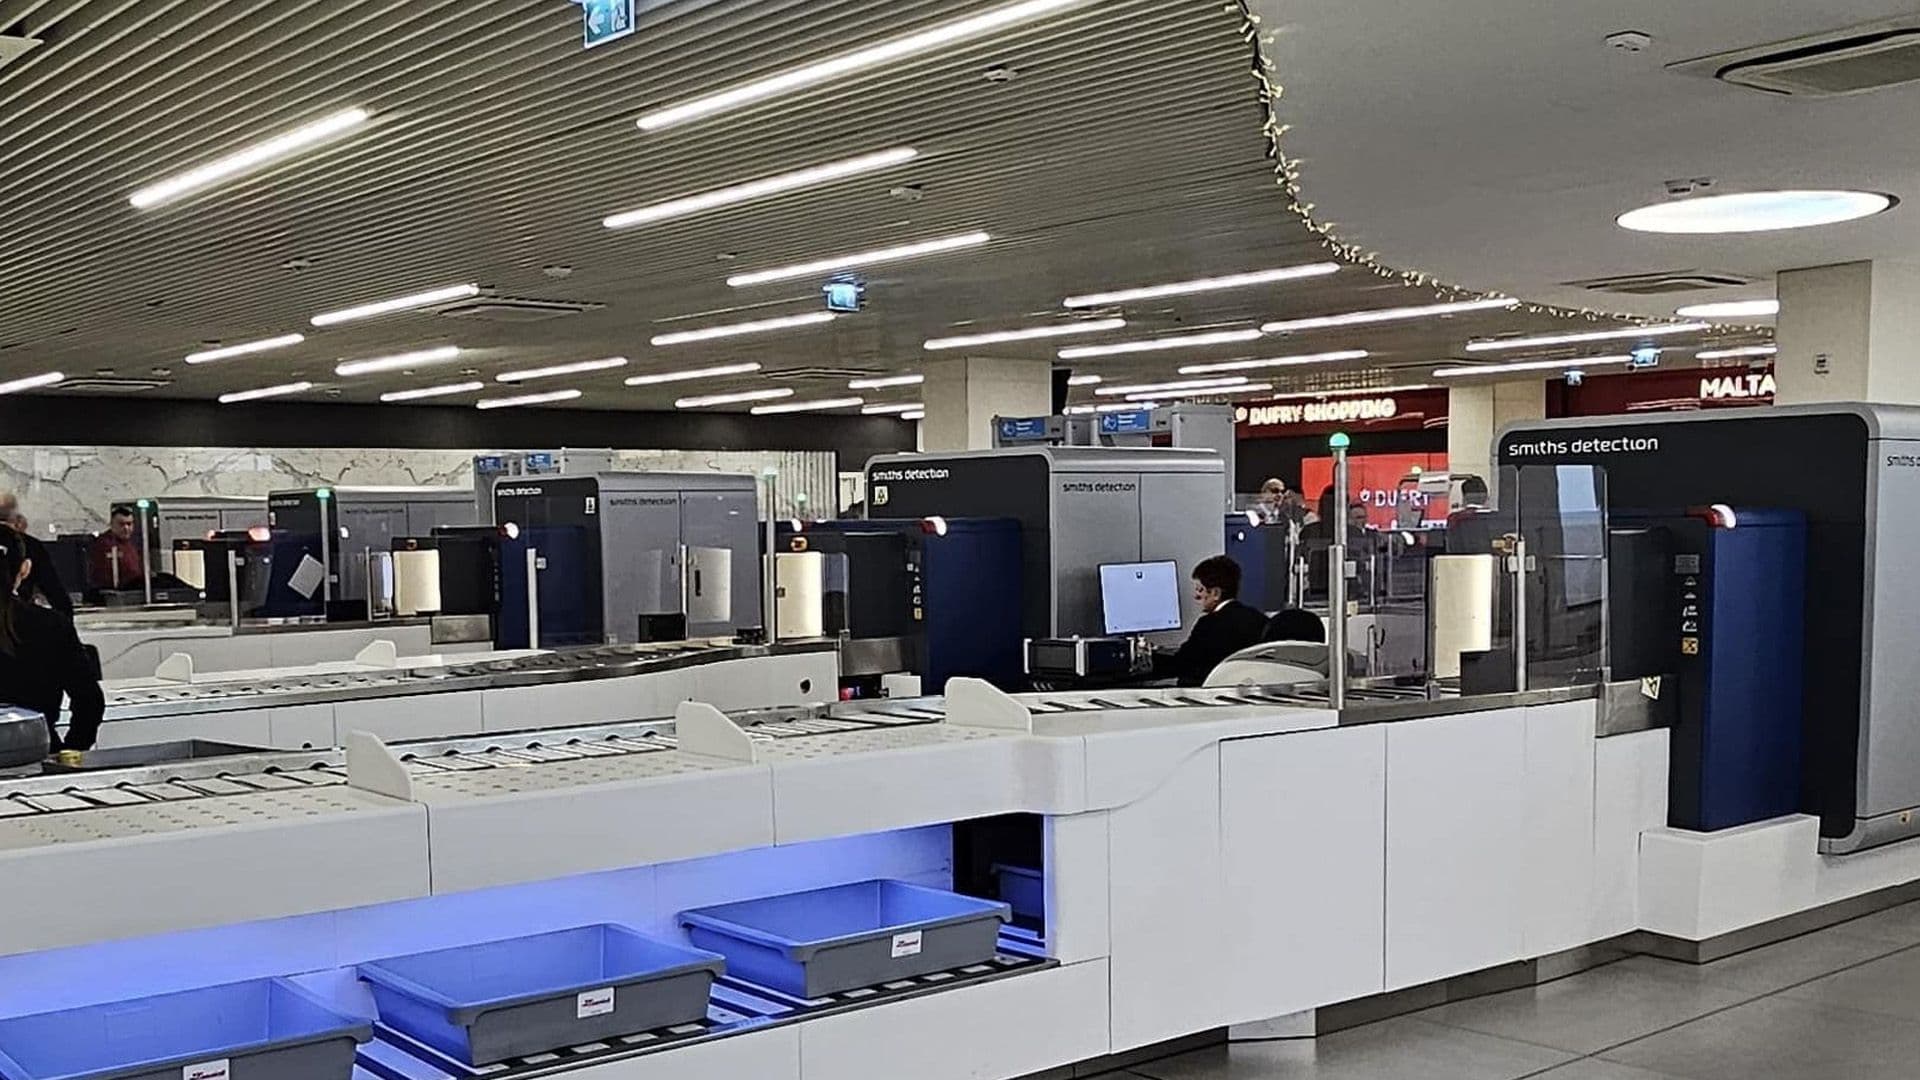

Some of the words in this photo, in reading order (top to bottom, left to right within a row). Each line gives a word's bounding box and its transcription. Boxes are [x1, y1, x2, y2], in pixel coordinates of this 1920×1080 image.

[1700, 374, 1776, 399] MALTA
[1249, 404, 1303, 425] DUFRY
[1303, 398, 1397, 421] SHOPPING
[1508, 441, 1568, 456] smiths
[1571, 437, 1659, 453] detection
[872, 470, 903, 481] smiths
[904, 468, 949, 480] detection
[1094, 481, 1136, 493] detection
